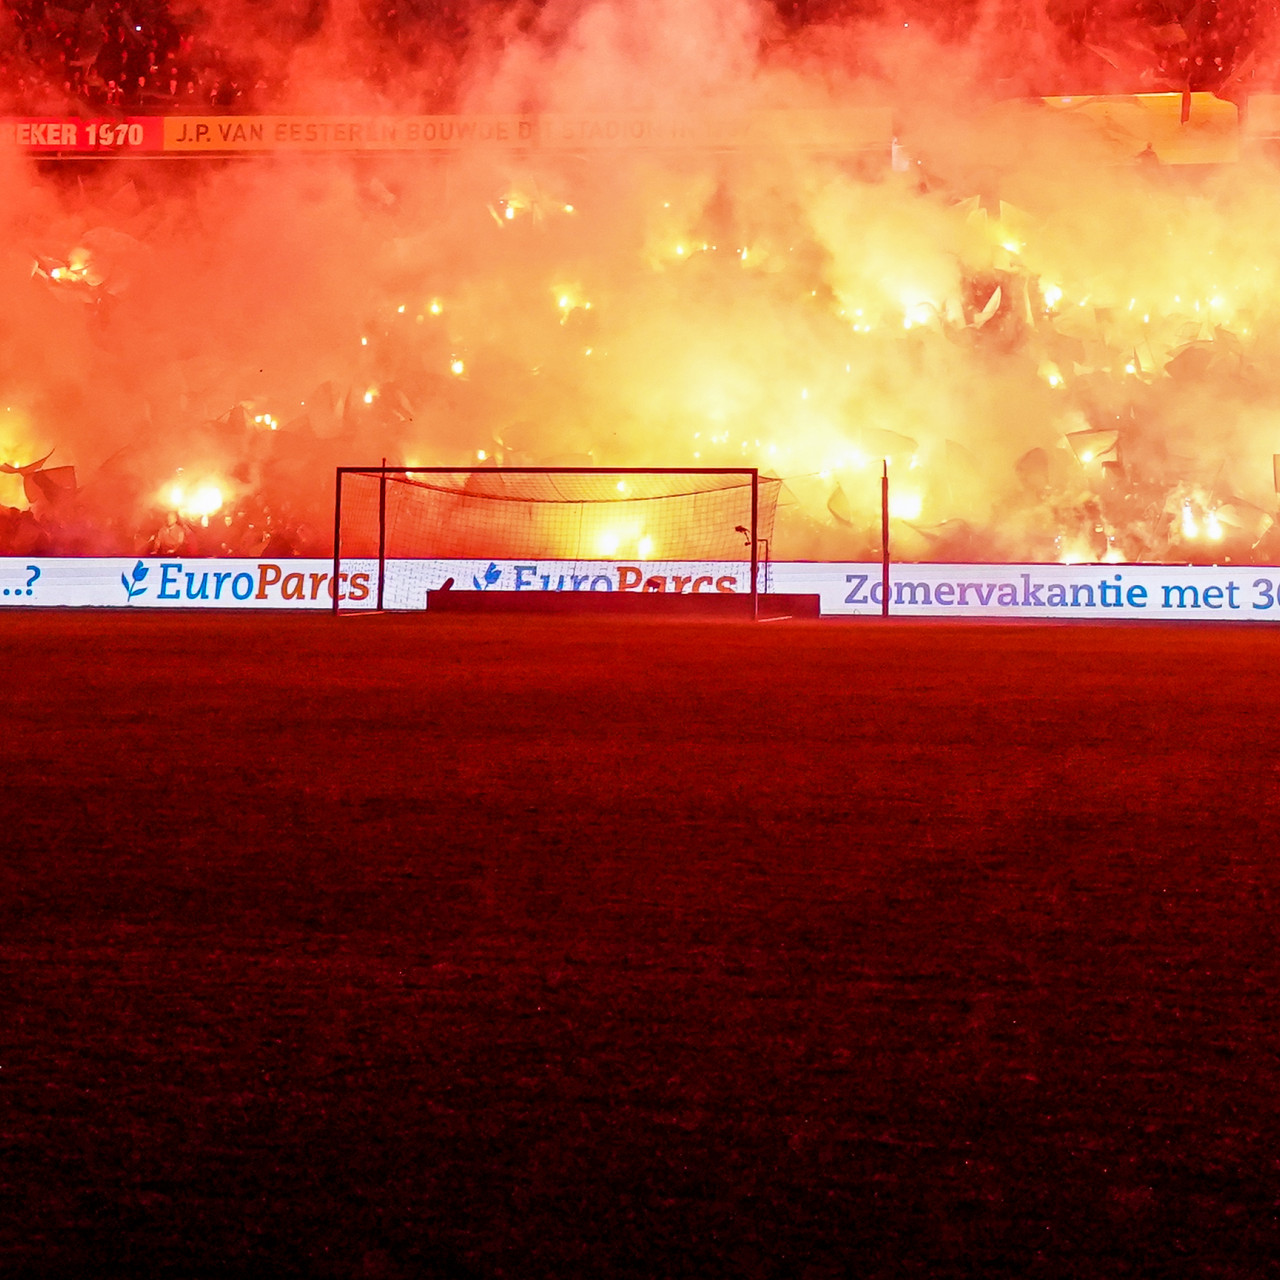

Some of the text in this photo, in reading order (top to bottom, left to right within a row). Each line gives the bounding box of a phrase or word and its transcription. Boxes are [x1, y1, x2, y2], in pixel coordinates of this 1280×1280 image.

[86, 123, 143, 145] 1970
[176, 123, 211, 142] J.P.
[218, 123, 263, 142] VAN
[158, 562, 370, 601] EuroParcs
[845, 573, 1148, 609] Zomervakantie
[1161, 580, 1239, 610] met
